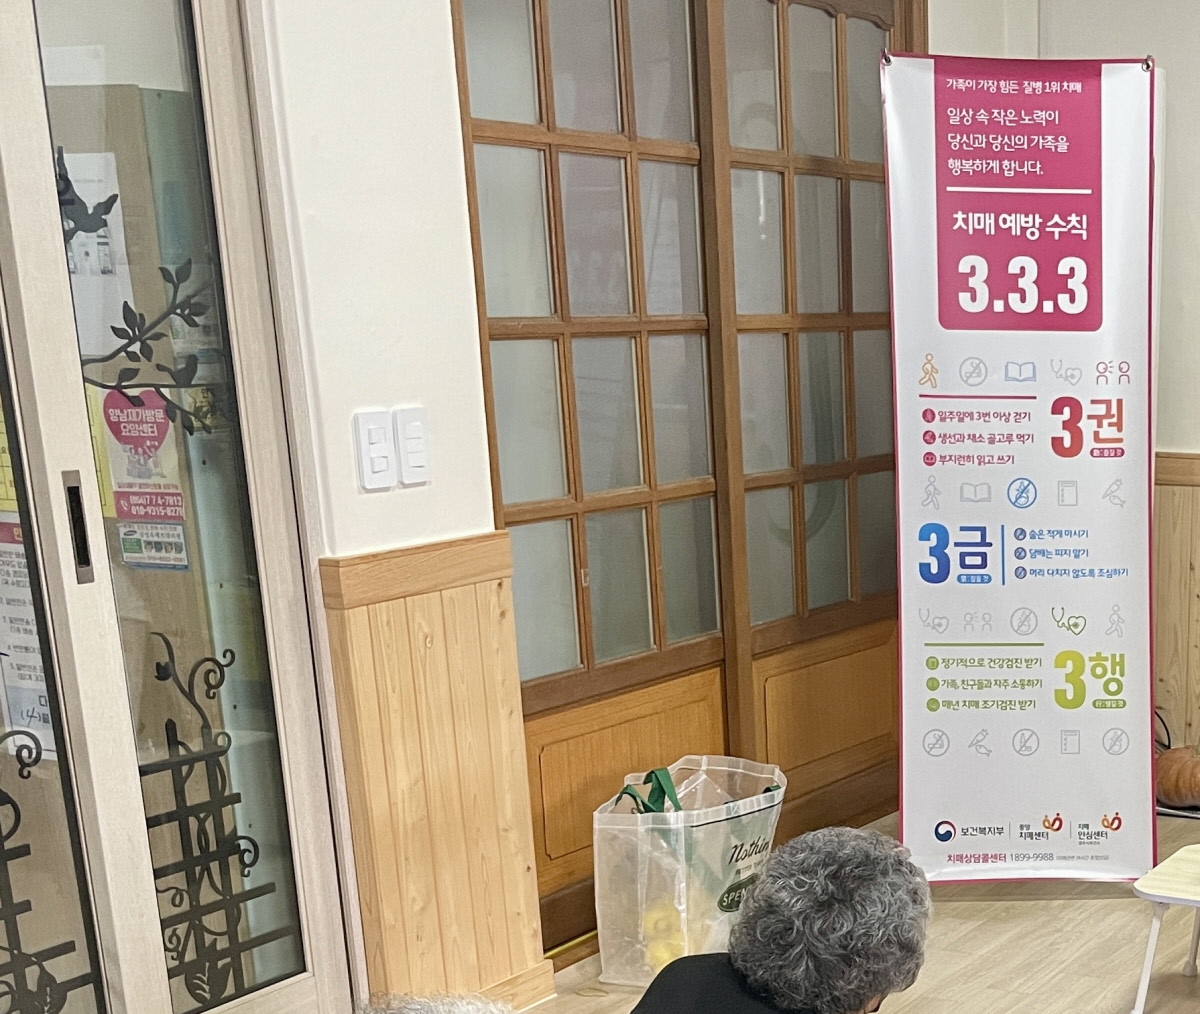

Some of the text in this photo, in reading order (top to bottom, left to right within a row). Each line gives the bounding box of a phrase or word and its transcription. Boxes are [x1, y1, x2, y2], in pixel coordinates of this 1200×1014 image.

[946, 79, 1082, 94] 가족이 가장 힘든 질병 1위 치매
[947, 107, 1059, 126] 일상 속 작은 노력이
[948, 134, 1069, 153] 당신과 당신의 가족을
[948, 158, 1043, 177] 행복하게 합니다.
[952, 211, 1088, 241] 치매 예방 수칙
[958, 255, 1088, 314] 3.3.3
[109, 409, 165, 422] 양남재가방문
[938, 411, 1031, 423] 일주일에 3번 이상 걷기
[121, 423, 158, 437] 요양센터
[1051, 396, 1124, 458] 3권
[938, 433, 1034, 445] 생선과 채소 골고루 먹기
[938, 454, 1014, 466] 부지런히 읽고 쓰기
[1029, 529, 1089, 540] 술은 적게 마시기
[918, 522, 993, 584] 3금
[1029, 548, 1089, 559] 담배는 피지 말기
[1029, 568, 1129, 579] 머리 다치지 않도록 조심하기
[941, 657, 1042, 670] 정기적으로 건강검진 받기
[961, 679, 992, 691] 친구들과
[993, 679, 1010, 690] 자주
[1011, 679, 1043, 690] 소통하기
[1054, 650, 1126, 710] 3행
[942, 700, 1036, 711] 매년 치매 조기검진 받기
[961, 826, 1005, 837] 보건복지부
[1019, 831, 1049, 841] 치매센터
[1077, 830, 1108, 841] 안심센터
[728, 836, 770, 865] Nothin
[947, 853, 1007, 864] 치매상담콜센터
[1010, 852, 1055, 862] 1899-9988
